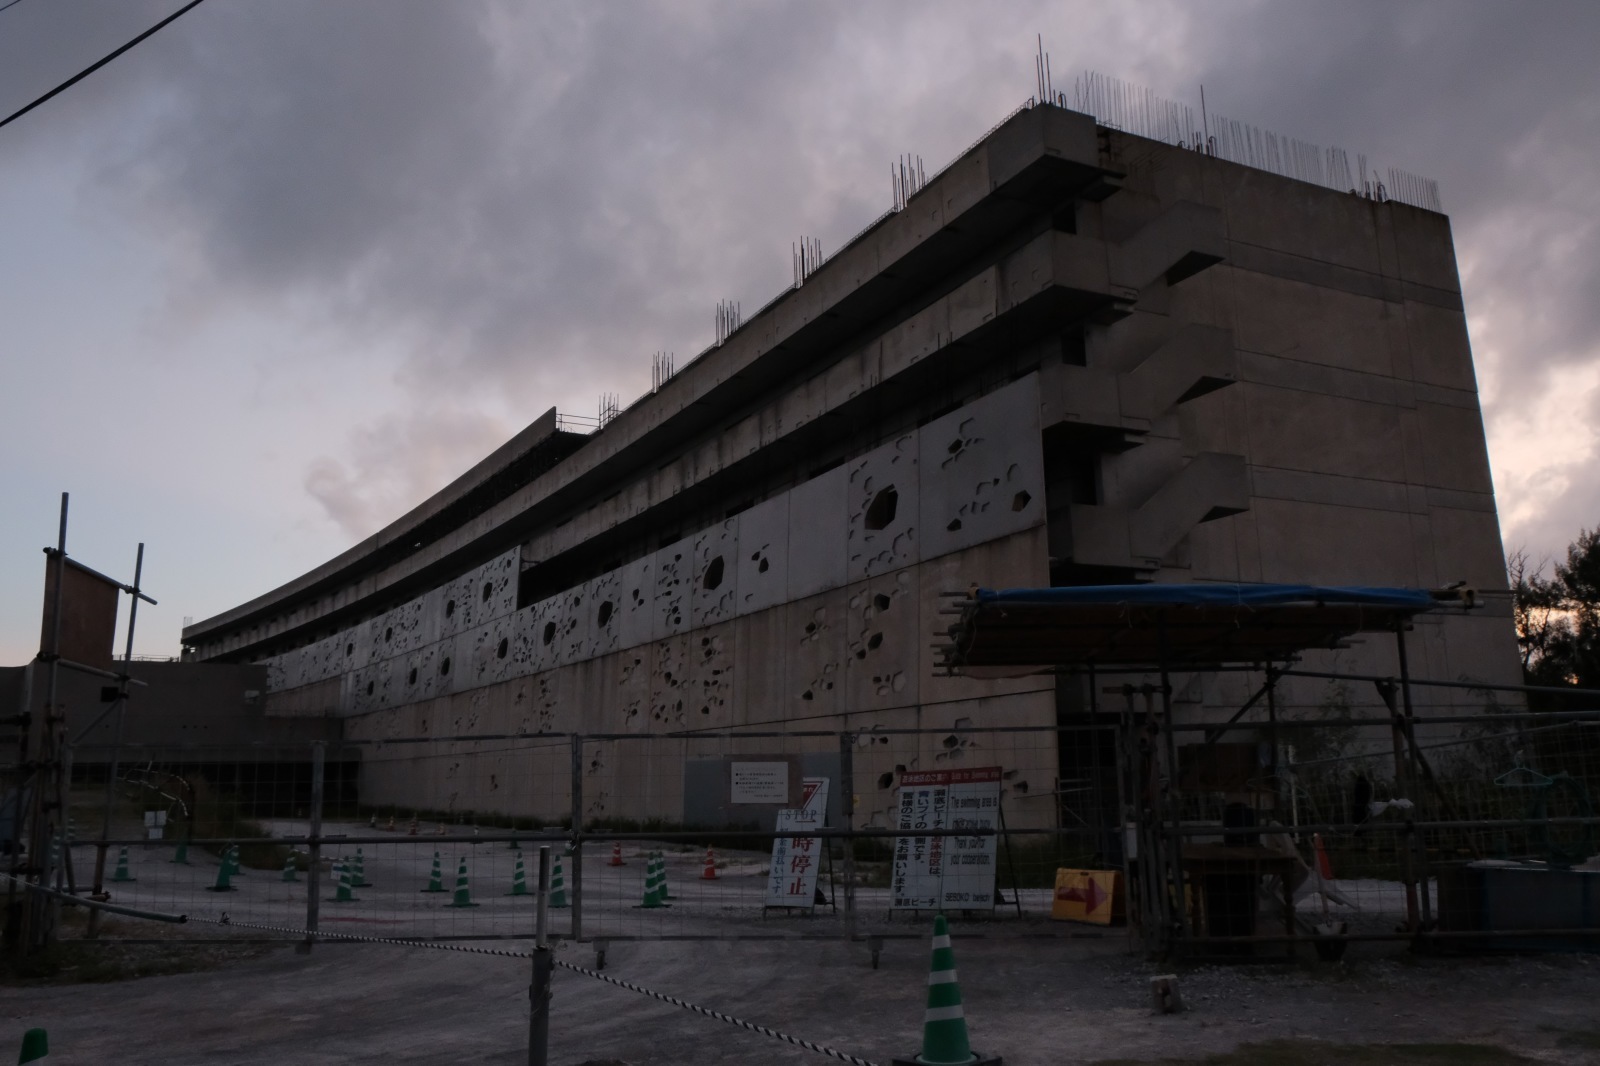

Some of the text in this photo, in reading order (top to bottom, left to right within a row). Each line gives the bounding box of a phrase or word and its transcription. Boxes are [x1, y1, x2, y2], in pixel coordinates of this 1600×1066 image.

[951, 796, 960, 808] The
[785, 809, 817, 821] STOP
[913, 790, 930, 864] 青いブイの側です。
[929, 789, 946, 878] 瀬底ビーチ遊泳地区は、
[893, 792, 914, 896] 皆様のご協をお願いします。
[954, 837, 967, 848] Thank
[772, 828, 789, 898] 金前払いです。
[786, 819, 817, 896] 一時停止
[951, 855, 961, 866] your
[894, 898, 936, 907] 瀬底ビーチ
[945, 892, 970, 902] SESOKO
